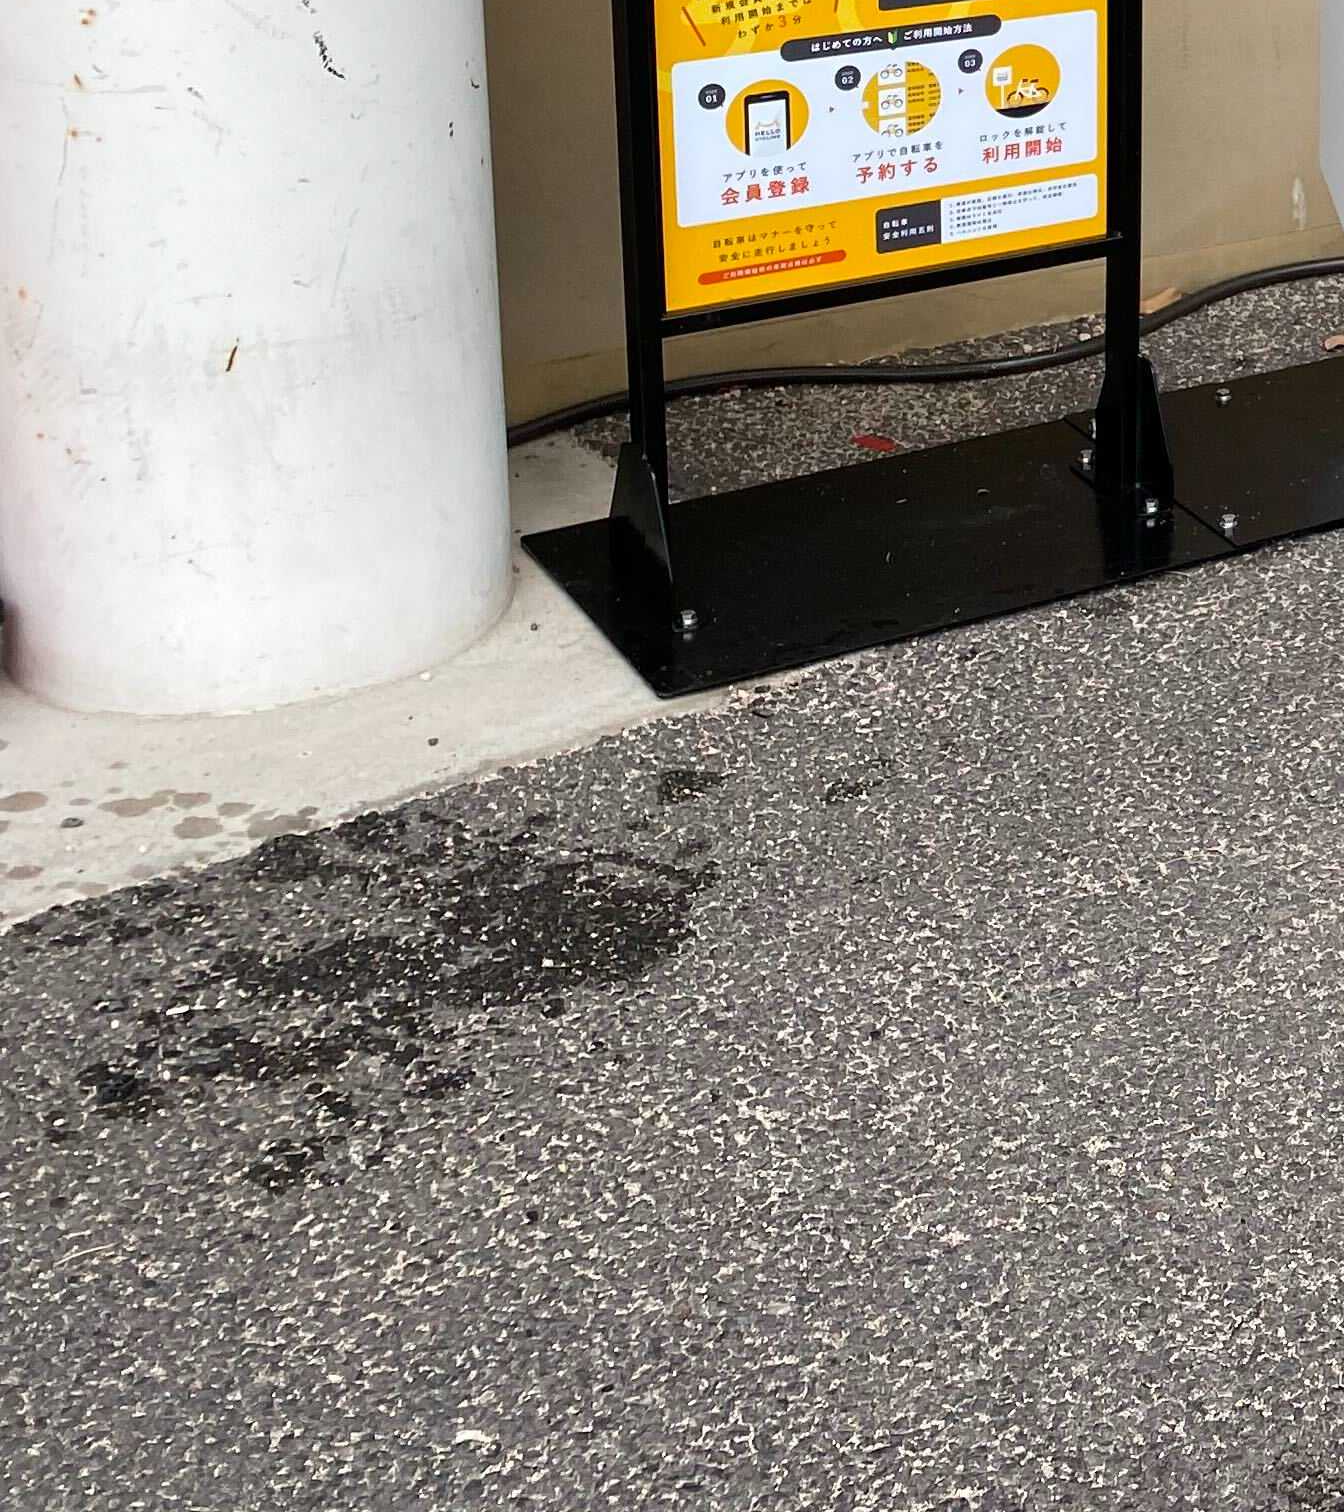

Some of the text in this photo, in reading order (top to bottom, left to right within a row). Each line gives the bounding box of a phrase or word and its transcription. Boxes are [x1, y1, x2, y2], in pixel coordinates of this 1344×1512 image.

[811, 36, 883, 52] はじめての方へ
[964, 59, 976, 68] 03
[841, 76, 855, 85] 02
[705, 94, 717, 104] 01
[852, 140, 944, 162] アプリで自転車を
[982, 137, 1065, 164] 利用開始
[722, 161, 807, 183] アプリを使って
[856, 156, 939, 184] 予約する
[721, 176, 810, 205] 会員登録
